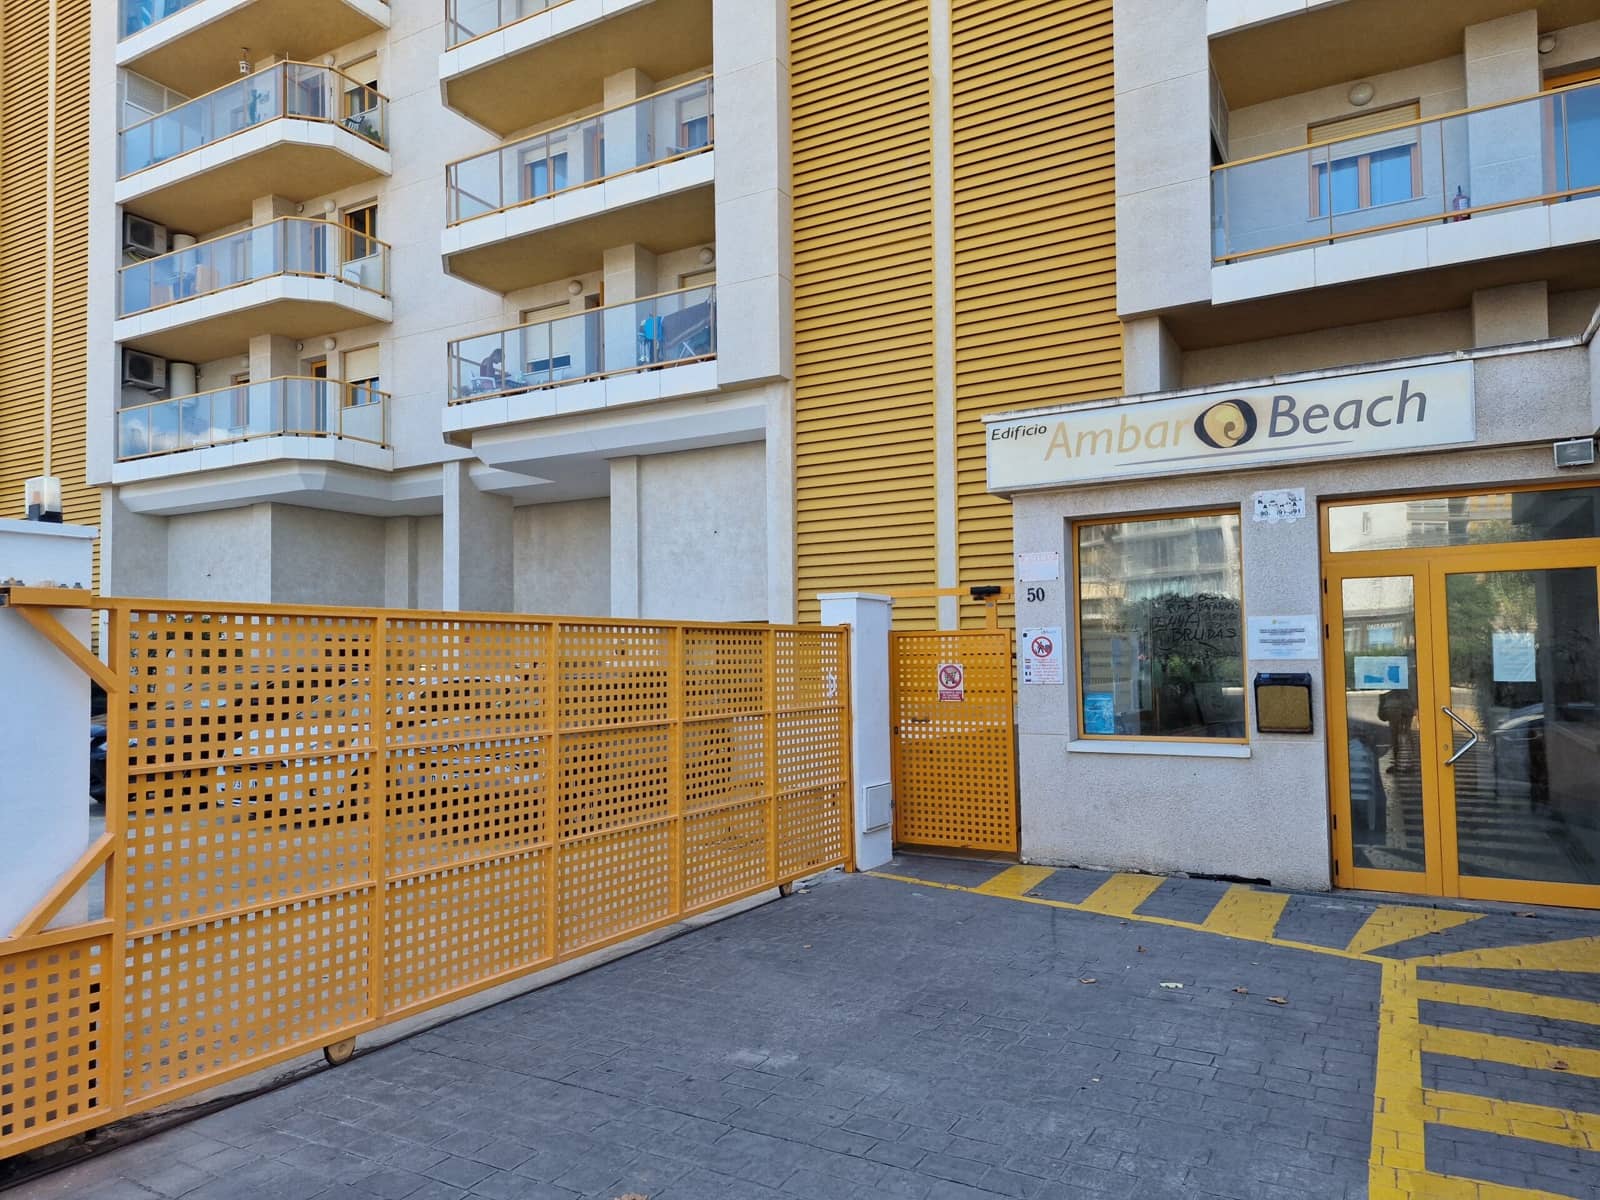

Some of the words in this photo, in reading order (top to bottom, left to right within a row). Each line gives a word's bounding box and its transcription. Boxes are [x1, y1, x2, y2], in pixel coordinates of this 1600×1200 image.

[991, 423, 1048, 441] Edificio
[1044, 413, 1192, 461] Ambar
[1268, 379, 1428, 438] Beach
[1026, 586, 1046, 603] 50
